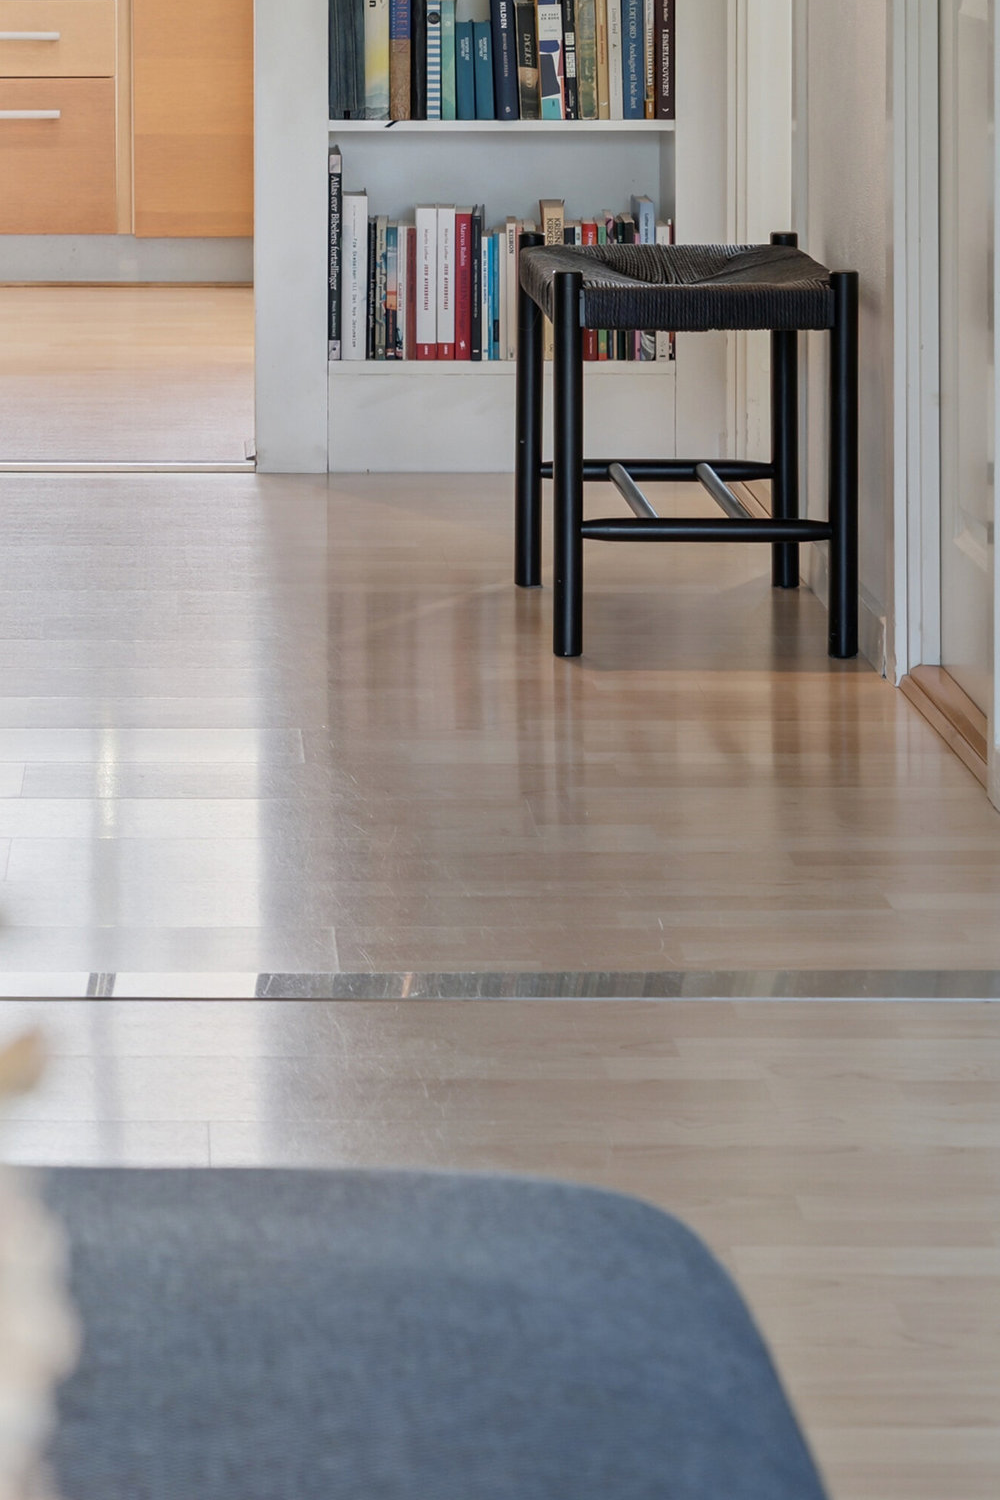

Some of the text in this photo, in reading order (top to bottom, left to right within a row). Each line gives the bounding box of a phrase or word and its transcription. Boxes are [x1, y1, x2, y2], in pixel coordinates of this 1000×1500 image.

[500, 1, 508, 29] KILDEN
[629, 7, 638, 19] DIT
[629, 20, 638, 39] ORD
[628, 42, 638, 72] Andagter
[662, 32, 670, 98] SMELTEOVNEN
[328, 175, 341, 291] Atlas over Bibelens fortællinger
[459, 222, 468, 267] Marcus Rubin
